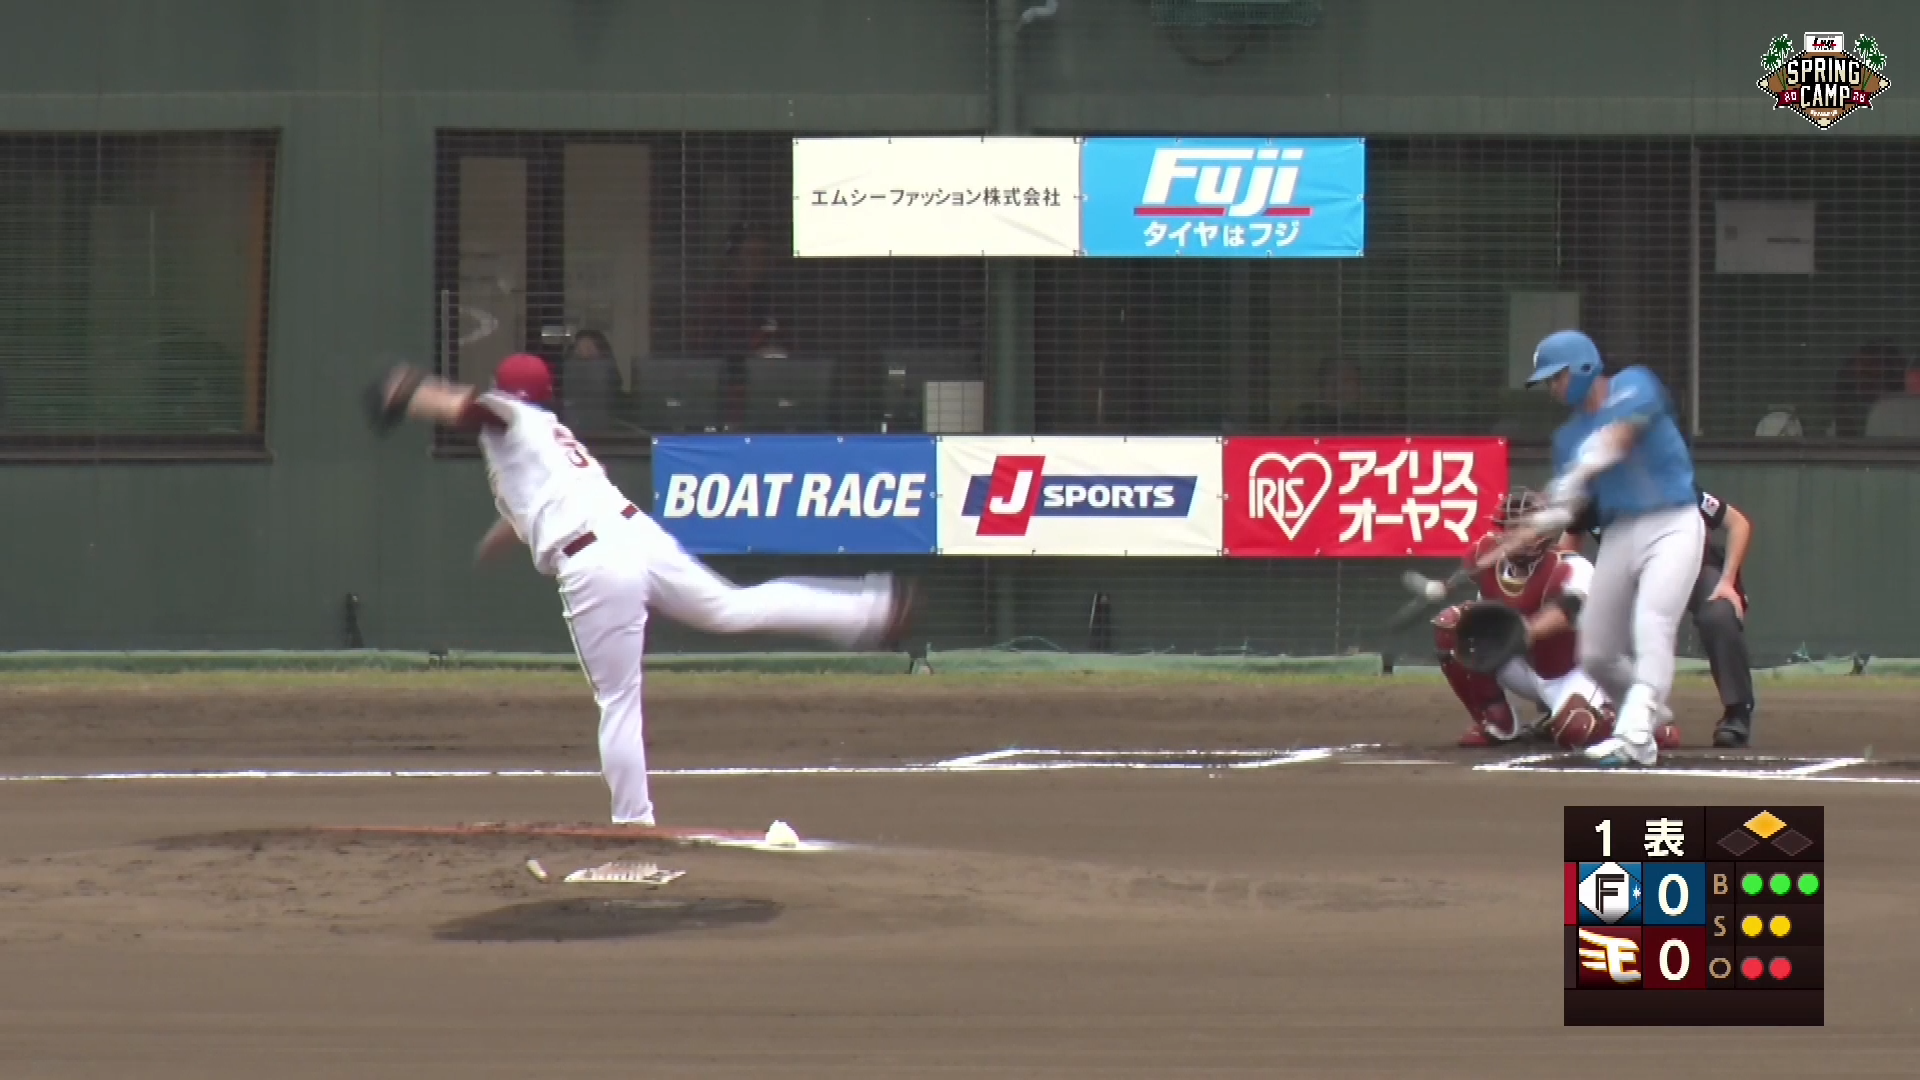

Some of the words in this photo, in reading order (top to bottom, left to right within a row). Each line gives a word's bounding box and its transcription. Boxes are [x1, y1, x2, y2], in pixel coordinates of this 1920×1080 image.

[810, 187, 1062, 207] エムシーファッション株式会社
[1142, 148, 1304, 217] Fuji
[1143, 220, 1300, 248] タイヤはフジ
[663, 472, 793, 519] BOAT
[796, 472, 926, 519] RACE
[988, 470, 1033, 515] J
[1043, 484, 1175, 509] SPORTS
[1338, 450, 1478, 496] アイリス
[1248, 477, 1305, 520] IRIS
[1338, 498, 1478, 543] オーヤマ
